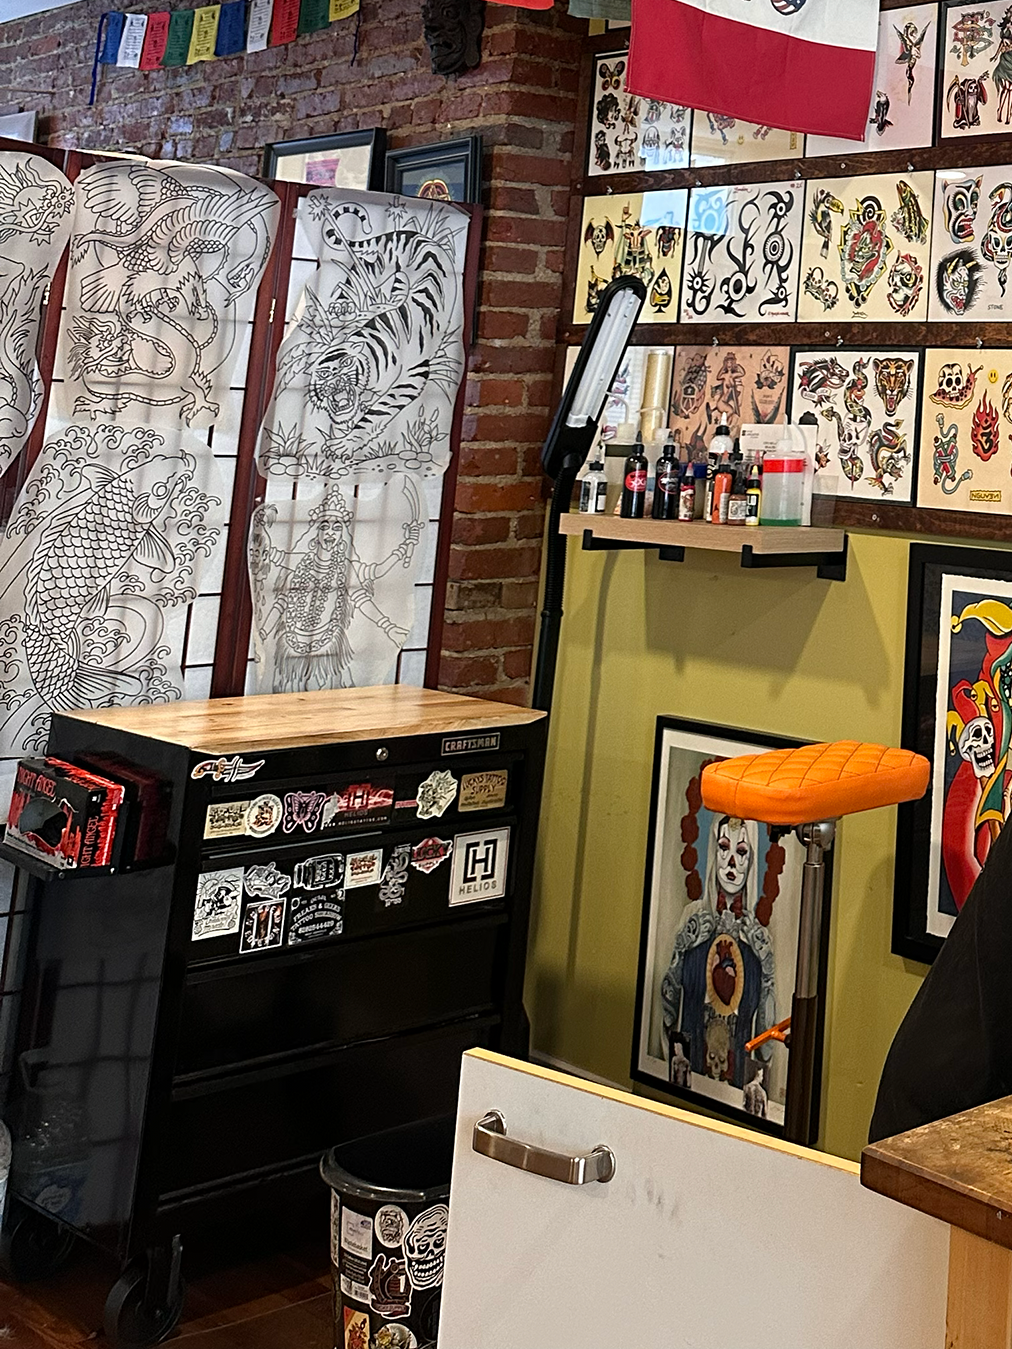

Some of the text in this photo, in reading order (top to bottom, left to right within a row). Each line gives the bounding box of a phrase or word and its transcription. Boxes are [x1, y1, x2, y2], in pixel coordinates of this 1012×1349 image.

[445, 736, 497, 752] CRAFTSMAN
[35, 774, 57, 798] ANGEL
[471, 784, 496, 795] SUPPLY
[81, 816, 99, 867] IGHT ANGEL
[459, 880, 498, 895] HELIOS
